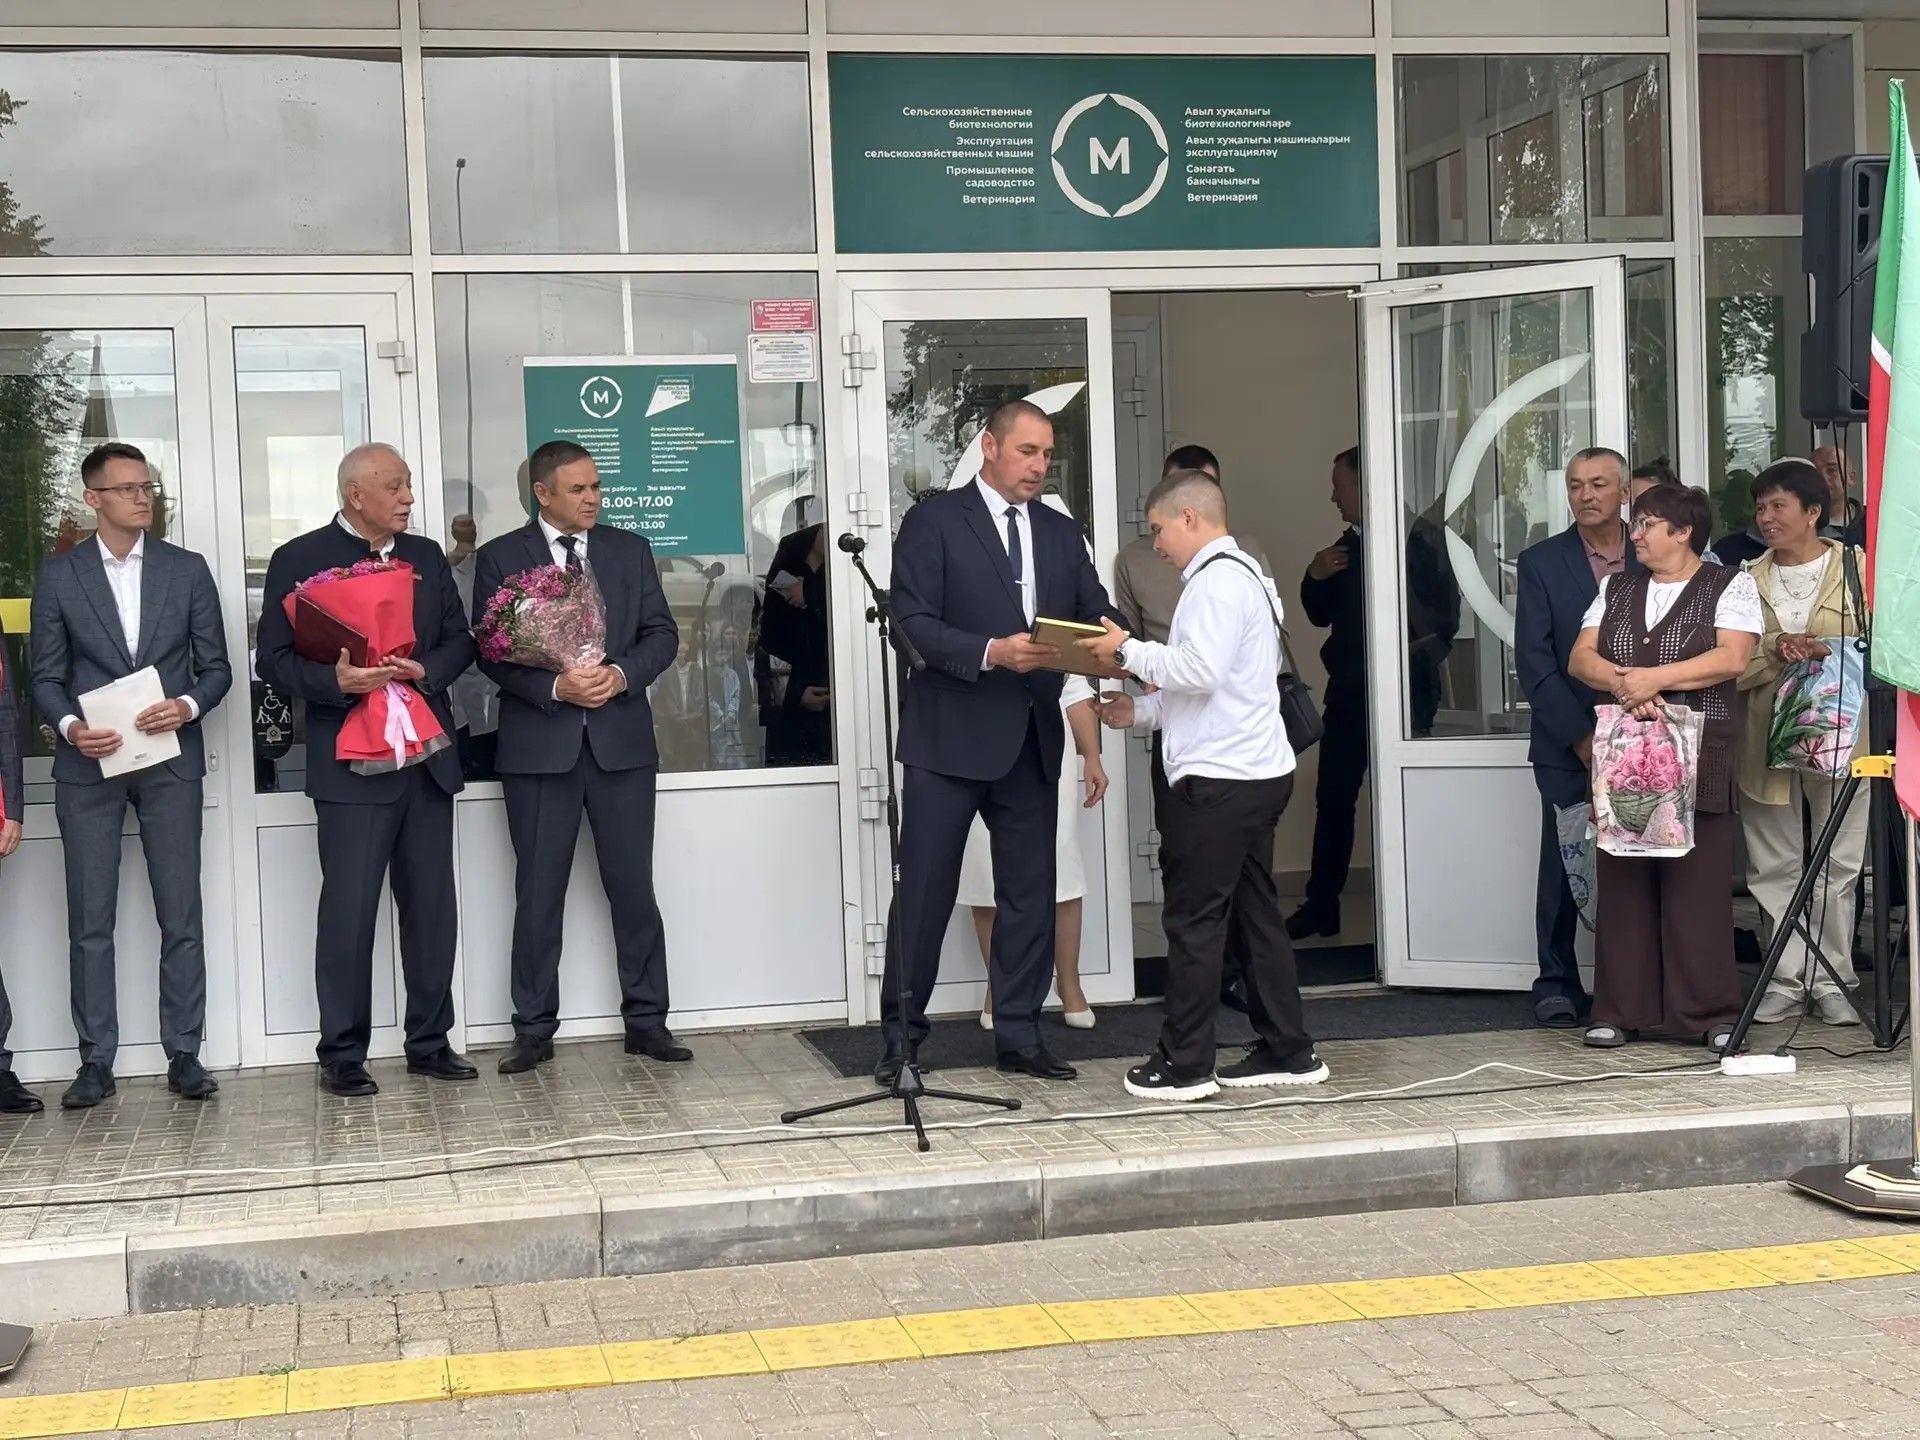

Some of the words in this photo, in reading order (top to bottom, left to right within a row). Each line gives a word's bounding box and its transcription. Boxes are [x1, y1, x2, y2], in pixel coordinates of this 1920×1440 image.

[902, 106, 1033, 117] Сельскохозяйственные
[1184, 106, 1214, 116] Авыл
[949, 119, 1033, 129] биотехнологии
[1185, 119, 1292, 130] биотехнологияләре
[956, 136, 1034, 147] Эксплуатация
[1185, 135, 1214, 145] Авыл
[1273, 135, 1351, 146] машиналарын
[864, 149, 993, 158] сельскохозяйственных
[995, 149, 1034, 158] машин
[946, 165, 1035, 176] Промышленное
[965, 179, 1035, 188] садоводство
[1186, 176, 1260, 186] бакчачылыгы
[963, 195, 1036, 205] Ветеринария
[1187, 192, 1258, 204] Ветеринария
[611, 485, 638, 493] работы
[601, 495, 674, 509] 8.00-17.00
[611, 520, 666, 530] 12.00-13.00
